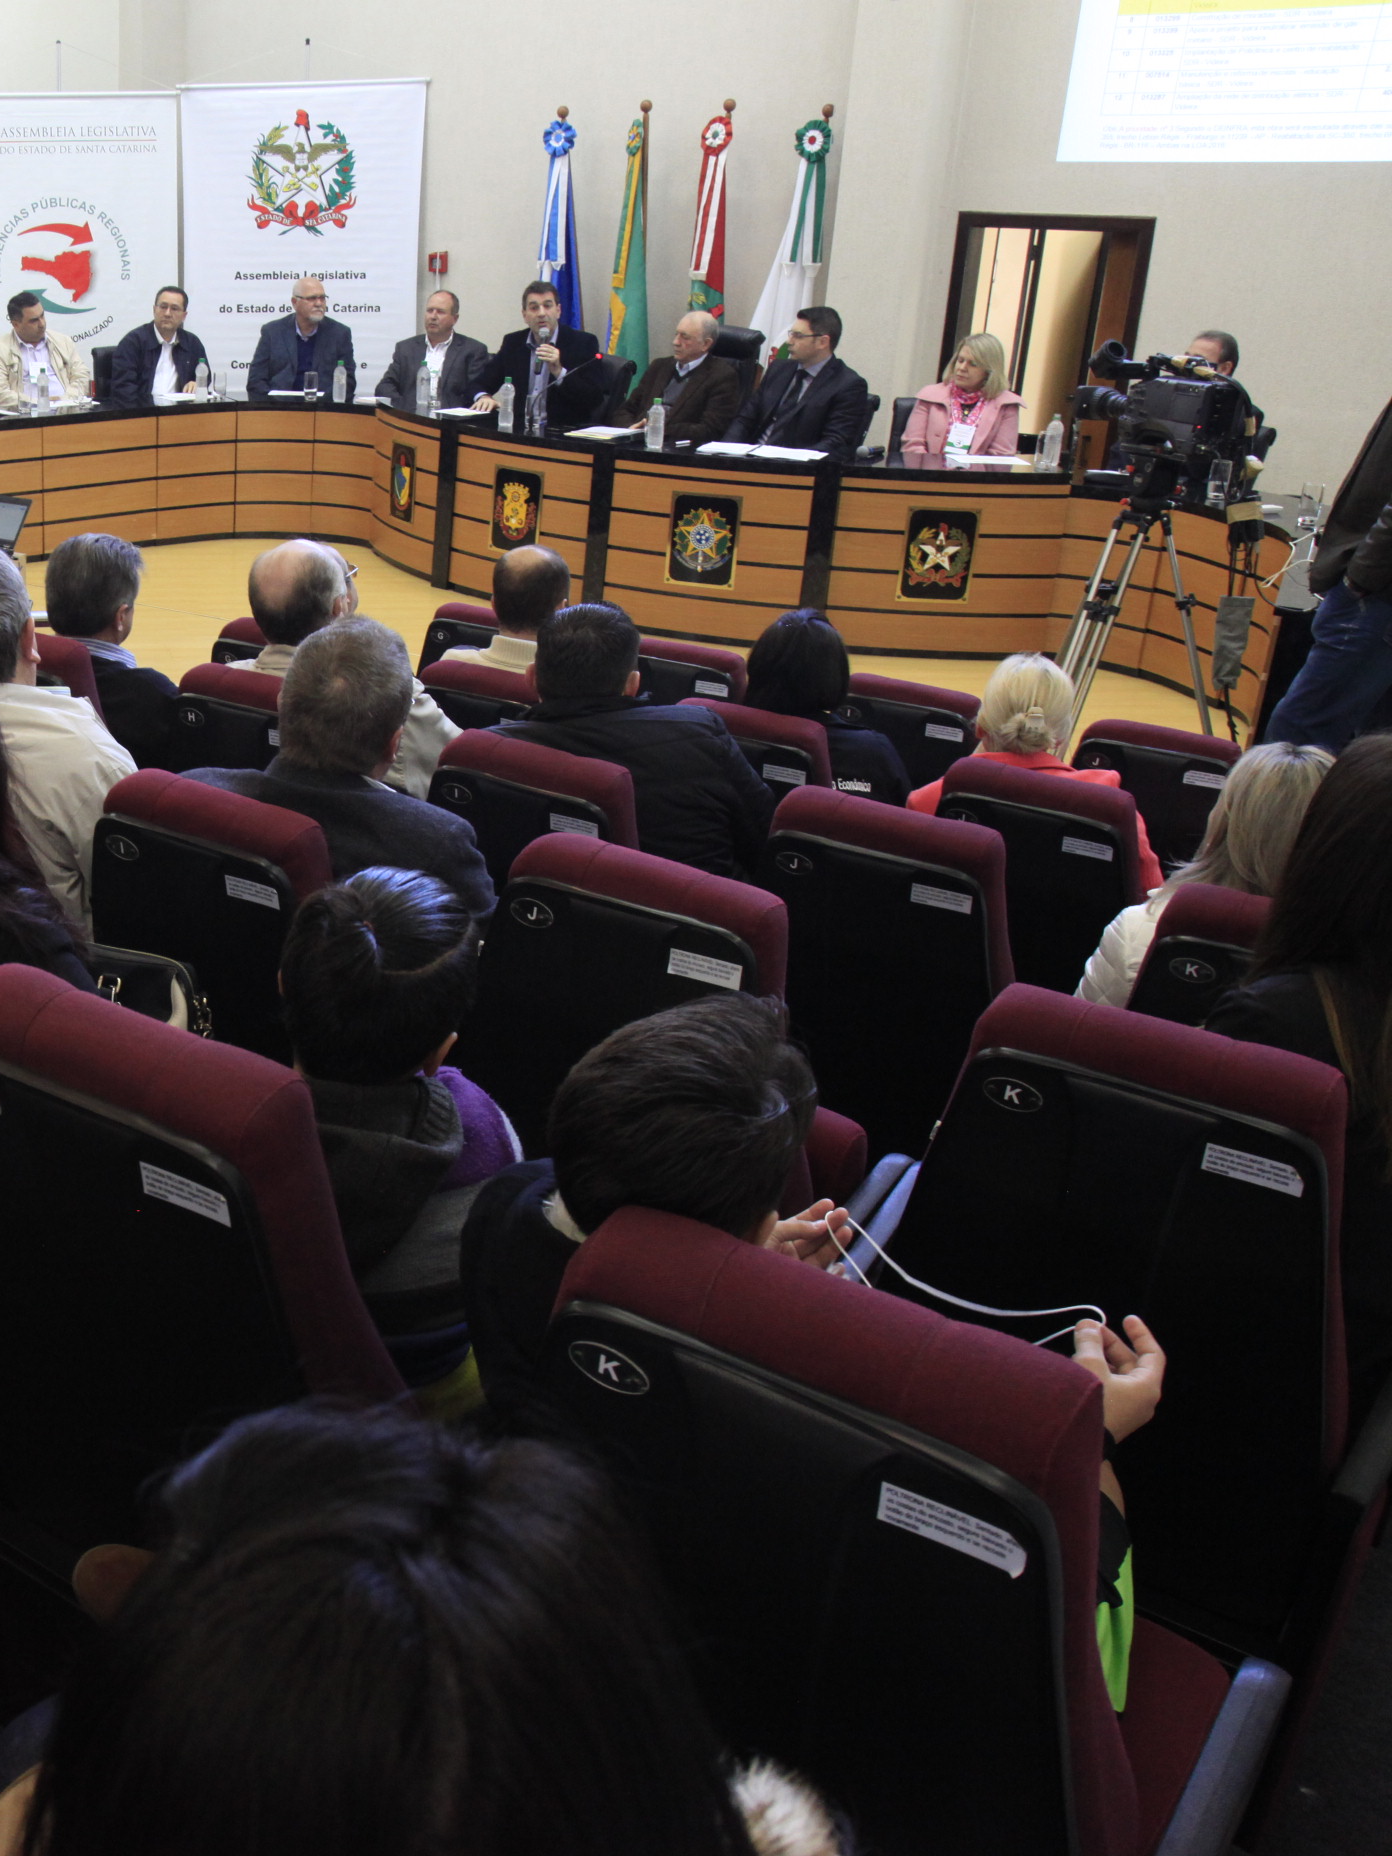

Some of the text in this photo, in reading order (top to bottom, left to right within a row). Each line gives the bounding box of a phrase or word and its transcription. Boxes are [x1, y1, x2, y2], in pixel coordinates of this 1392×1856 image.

[0, 125, 157, 138] ASSEMBLEIA LEGISLATIVA
[0, 144, 157, 155] DO ESTADO DE SANTA CATARINA
[31, 197, 96, 216] PÚBLICAS
[97, 211, 130, 281] REGIONAIS
[234, 271, 300, 280] Assembleia
[219, 304, 292, 313] do Estado de
[333, 303, 381, 312] Catarina
[187, 712, 195, 722] H
[1092, 757, 1100, 766] J
[789, 858, 798, 869] J
[527, 906, 537, 920] J
[1185, 963, 1199, 978] K
[1003, 1085, 1023, 1104] K
[598, 1354, 620, 1382] K
